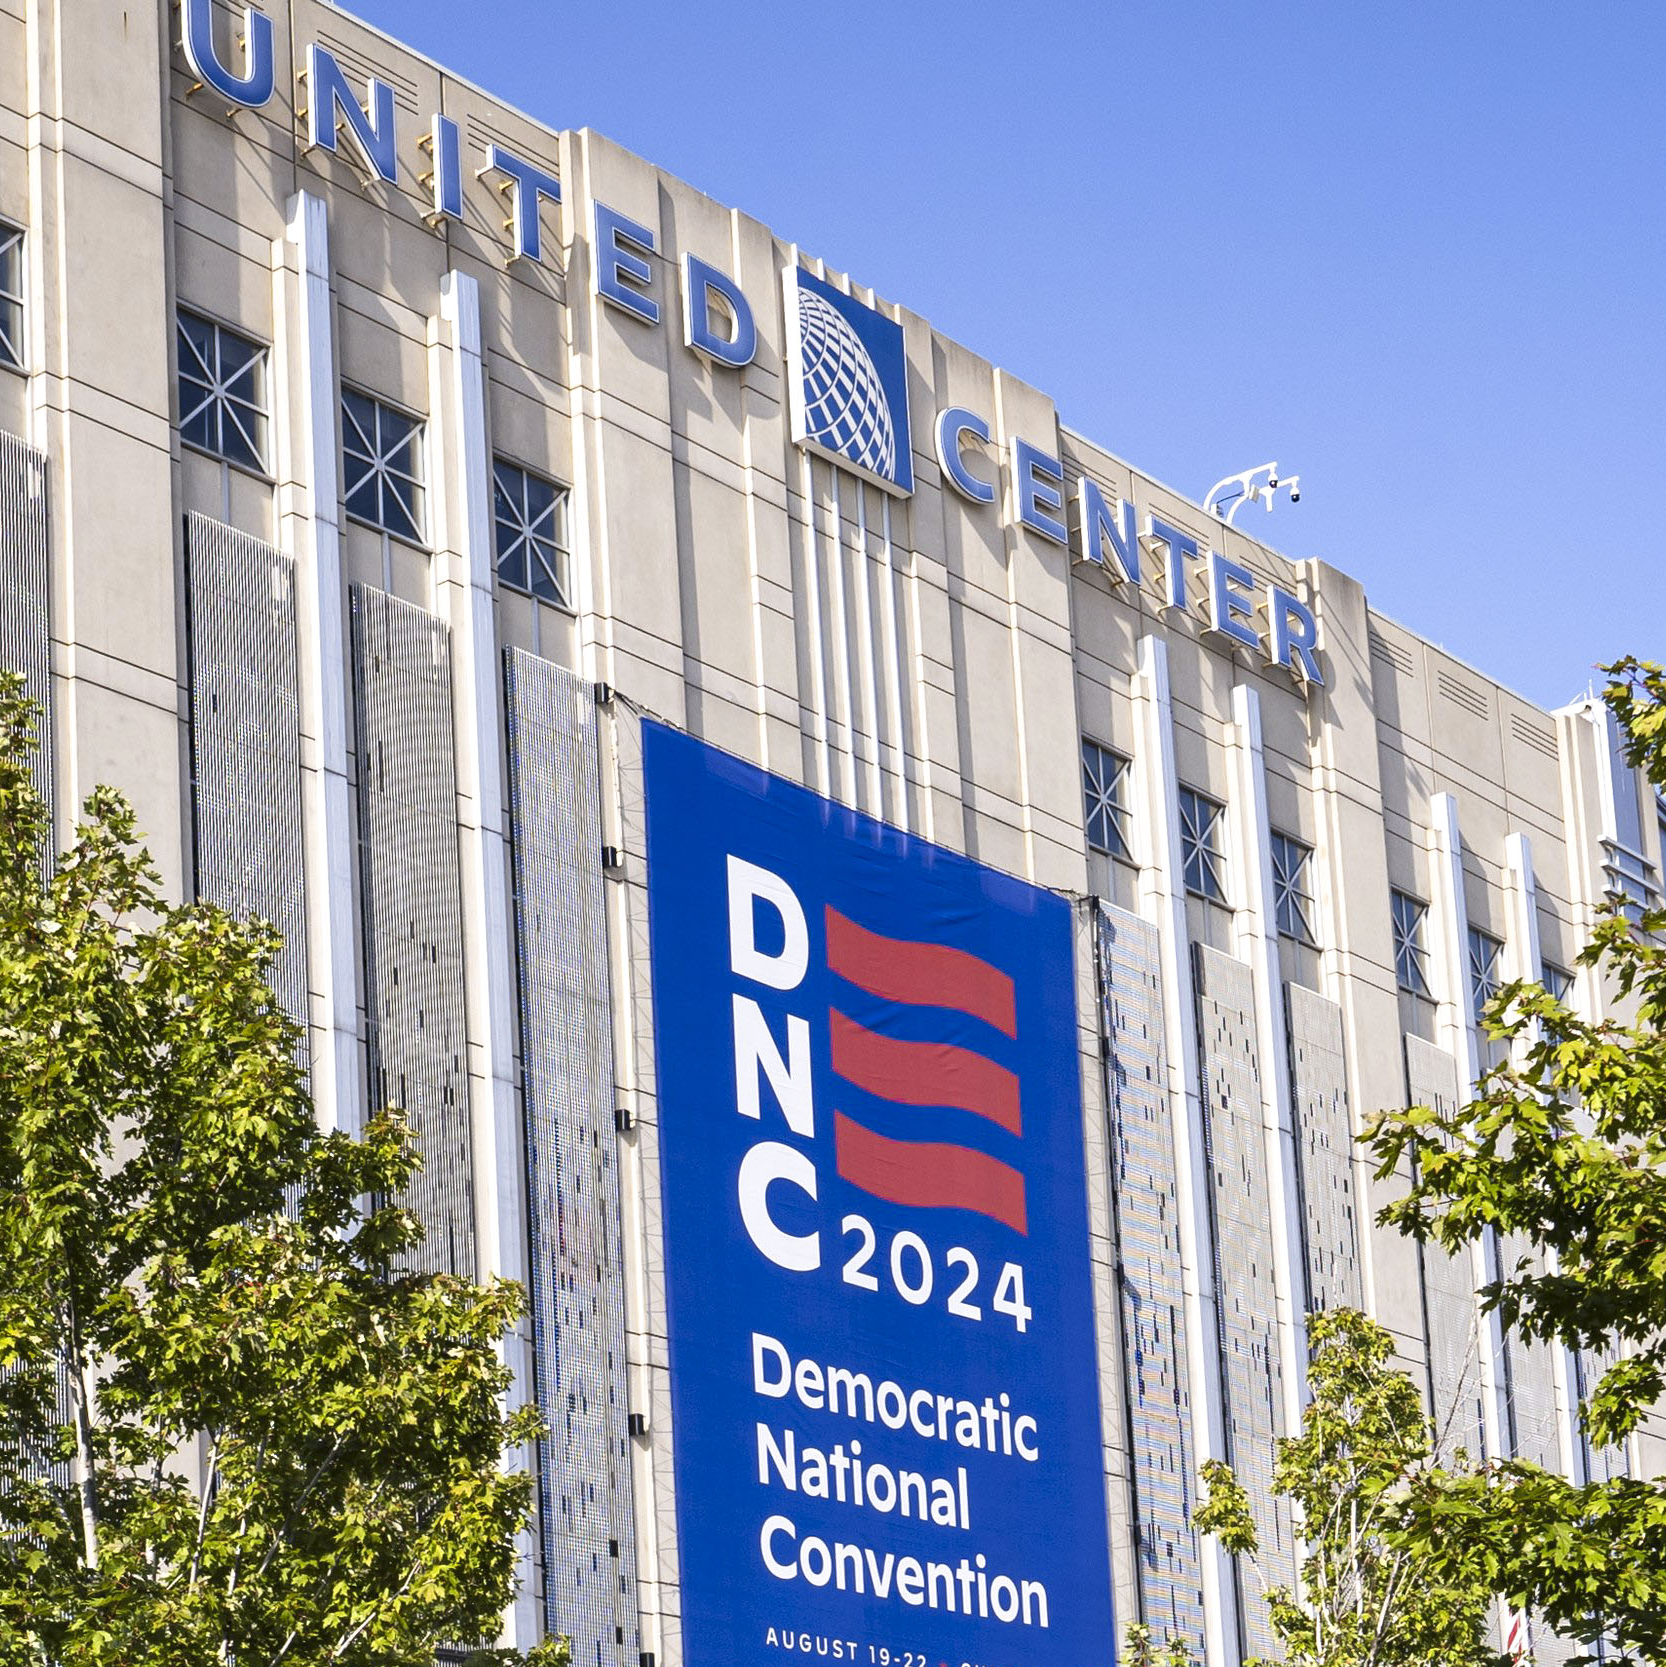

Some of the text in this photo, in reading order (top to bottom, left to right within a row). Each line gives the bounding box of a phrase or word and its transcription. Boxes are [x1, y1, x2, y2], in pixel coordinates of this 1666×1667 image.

[181, 0, 1326, 687] UNITED CENTER
[726, 853, 821, 1272] DNC
[841, 1213, 1033, 1333] 2024
[751, 1331, 1039, 1461] Democratic
[756, 1422, 971, 1530] National
[760, 1514, 1049, 1628] Convention
[766, 1627, 858, 1660] AUGUST
